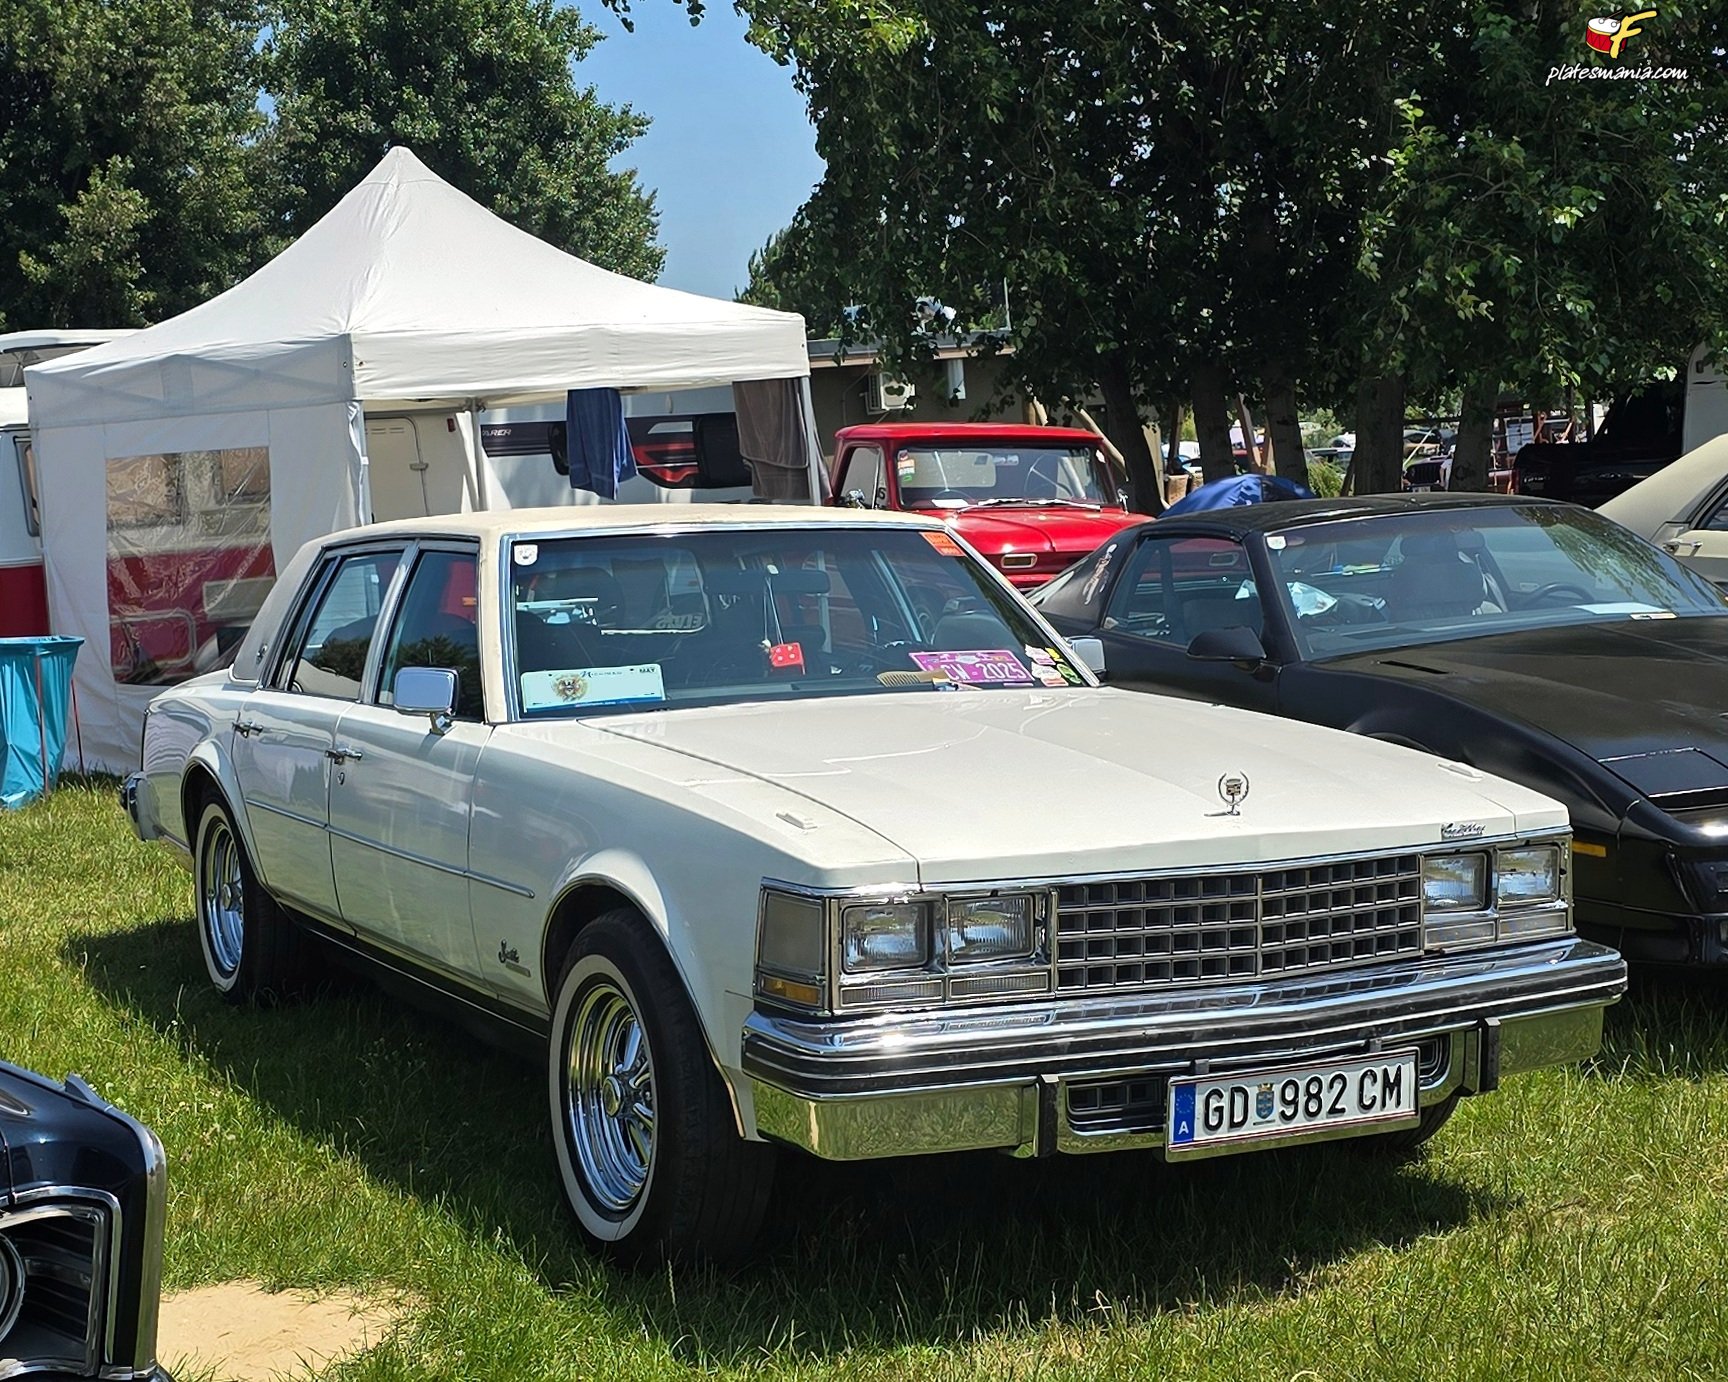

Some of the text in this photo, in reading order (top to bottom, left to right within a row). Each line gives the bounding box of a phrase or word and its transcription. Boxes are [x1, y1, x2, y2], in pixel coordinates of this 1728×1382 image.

[975, 662, 1027, 679] 2025
[1204, 1064, 1402, 1132] GD 982 CM
[1178, 1121, 1189, 1135] A
